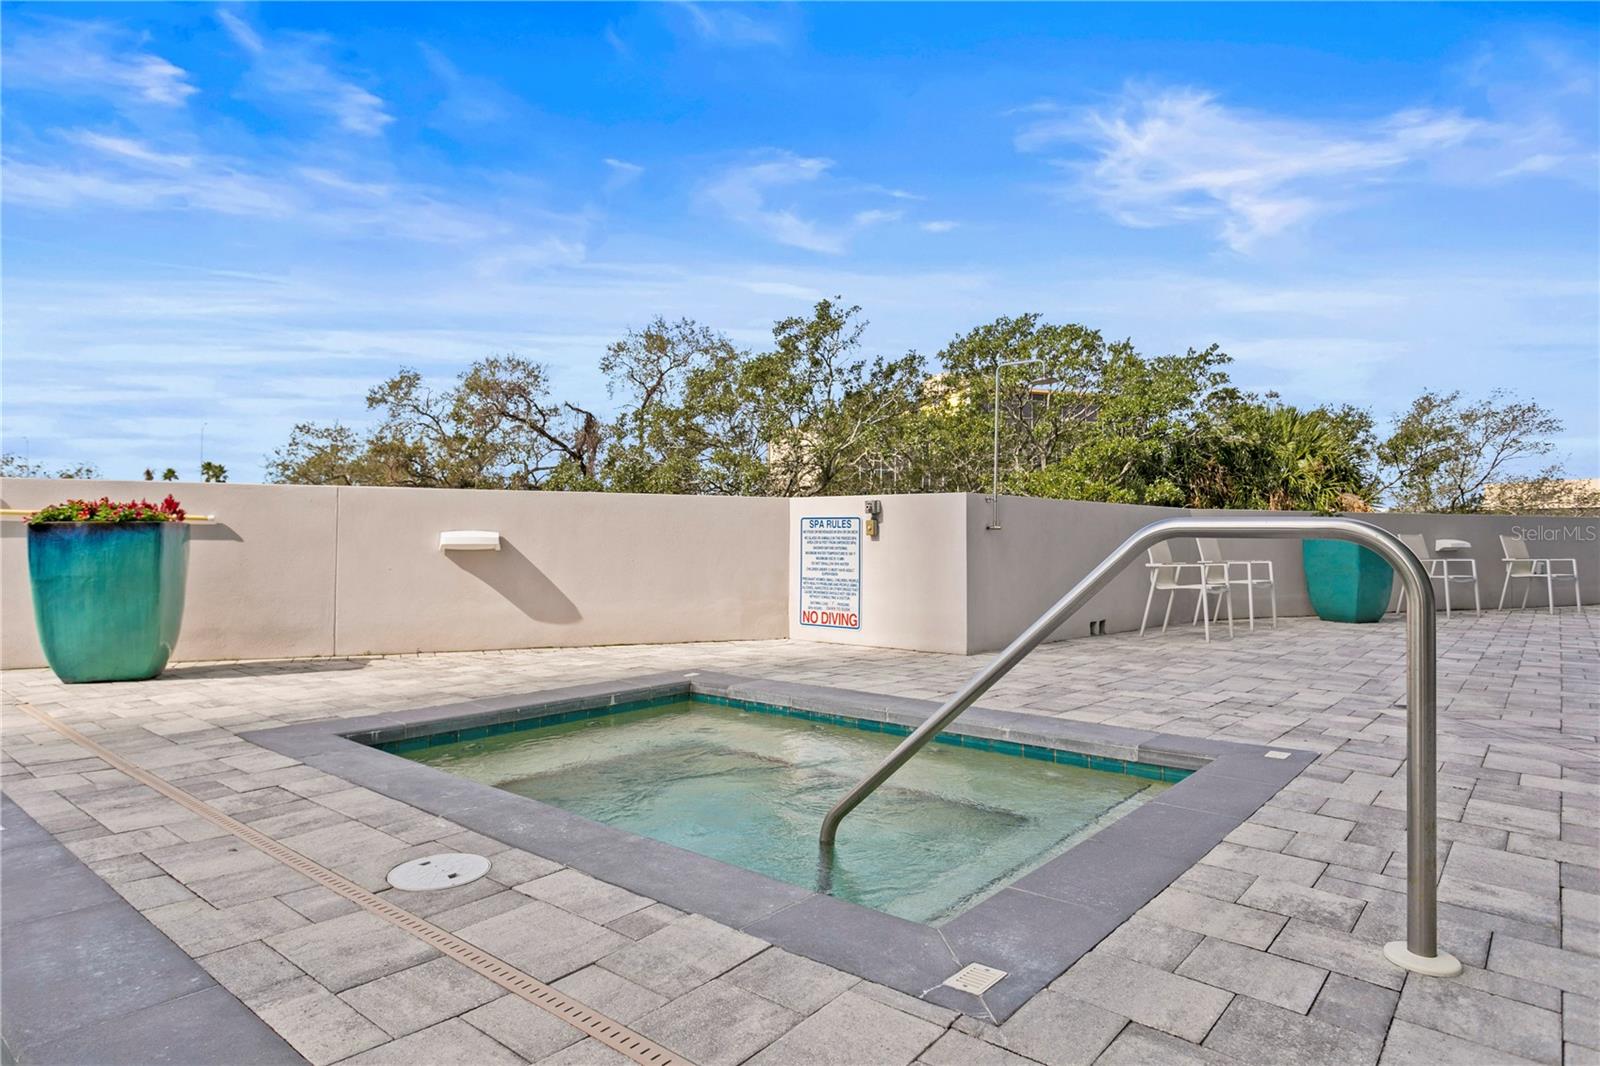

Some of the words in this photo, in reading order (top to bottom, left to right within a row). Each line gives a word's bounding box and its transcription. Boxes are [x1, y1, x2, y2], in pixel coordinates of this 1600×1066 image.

[809, 519, 825, 529] SPA
[826, 519, 852, 529] RULES
[802, 610, 819, 624] NO
[821, 611, 858, 627] DIVING
